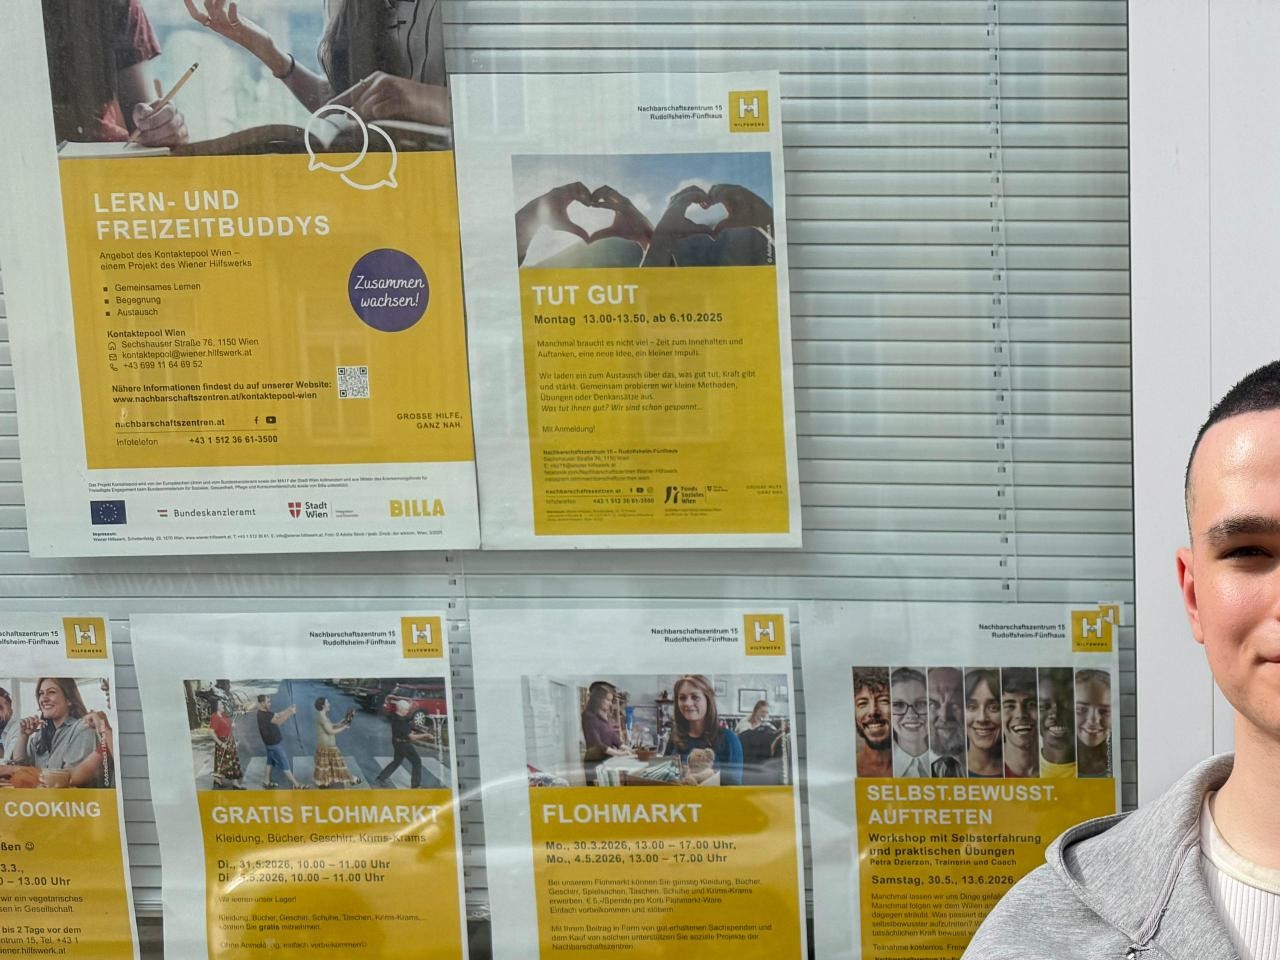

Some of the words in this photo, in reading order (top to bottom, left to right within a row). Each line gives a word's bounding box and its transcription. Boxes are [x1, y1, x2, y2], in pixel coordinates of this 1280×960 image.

[94, 191, 174, 212] LERN-
[184, 189, 238, 210] UND
[97, 215, 329, 239] FREIZEITBUDDYS
[99, 251, 134, 260] Angebot
[154, 249, 208, 258] Kontaktepool
[128, 261, 157, 270] Projekt
[177, 260, 206, 268] Wiener
[209, 259, 251, 267] Hilfswerks
[114, 283, 172, 291] Gemeinsames
[173, 282, 200, 290] Lernen
[354, 275, 424, 290] Zusammen
[360, 293, 418, 306] wachsen!
[531, 285, 579, 305] TUT
[587, 284, 638, 304] GUT
[115, 296, 160, 305] Begegnung
[117, 308, 158, 316] Austausch
[534, 314, 575, 325] Montag
[583, 313, 648, 323] 13.00-13.50,
[652, 313, 665, 322] ab
[669, 312, 722, 322] 6.10.2025
[107, 329, 163, 337] Kontaktepool
[121, 340, 172, 348] Sechshauser
[174, 338, 200, 346] Straße
[203, 338, 214, 346] 76,
[238, 337, 258, 345] Wien
[122, 349, 252, 359] kontaktepool@wiener.hilfswerk.at
[123, 361, 138, 369] +43
[168, 360, 178, 368] 64
[192, 360, 203, 368] 52
[112, 384, 140, 392] Nähere
[143, 383, 200, 391] Informationen
[202, 382, 231, 390] findest
[246, 381, 259, 389] auf
[295, 380, 331, 388] Website:
[396, 412, 432, 420] GROSSE
[189, 436, 204, 444] +43
[232, 435, 242, 443] 36
[304, 501, 327, 509] Stadt
[389, 499, 444, 516] BILLA
[173, 508, 255, 517] Bundeskanzleramt
[4, 801, 100, 816] COOKING
[212, 806, 293, 823] GRATIS
[300, 805, 440, 823] FLOHMARKT
[543, 803, 701, 822] FLOHMARKT
[868, 808, 991, 824] AUFTRETEN
[216, 832, 264, 844] Kleidung,
[267, 832, 305, 843] Bücher,
[868, 833, 925, 843] Workshop
[930, 833, 947, 842] mit
[951, 833, 1040, 845] Selbsterfahrung
[635, 840, 665, 849] 13.00
[679, 840, 708, 849] 17.00
[869, 846, 890, 857] und
[894, 846, 960, 857] praktischen
[965, 844, 1014, 858] Übungen
[574, 854, 624, 863] 4.5.2026,
[629, 853, 658, 862] 13.00
[673, 853, 702, 862] 17.00
[707, 853, 726, 862] Uhr
[217, 859, 235, 869] Di.,
[298, 860, 325, 869] 10.00
[339, 859, 366, 868] 11.00
[370, 859, 389, 868] Uhr
[18, 876, 46, 885] 13.00
[51, 877, 70, 885] Uhr
[871, 875, 923, 886] Samstag,
[928, 875, 957, 884] 30.5.,
